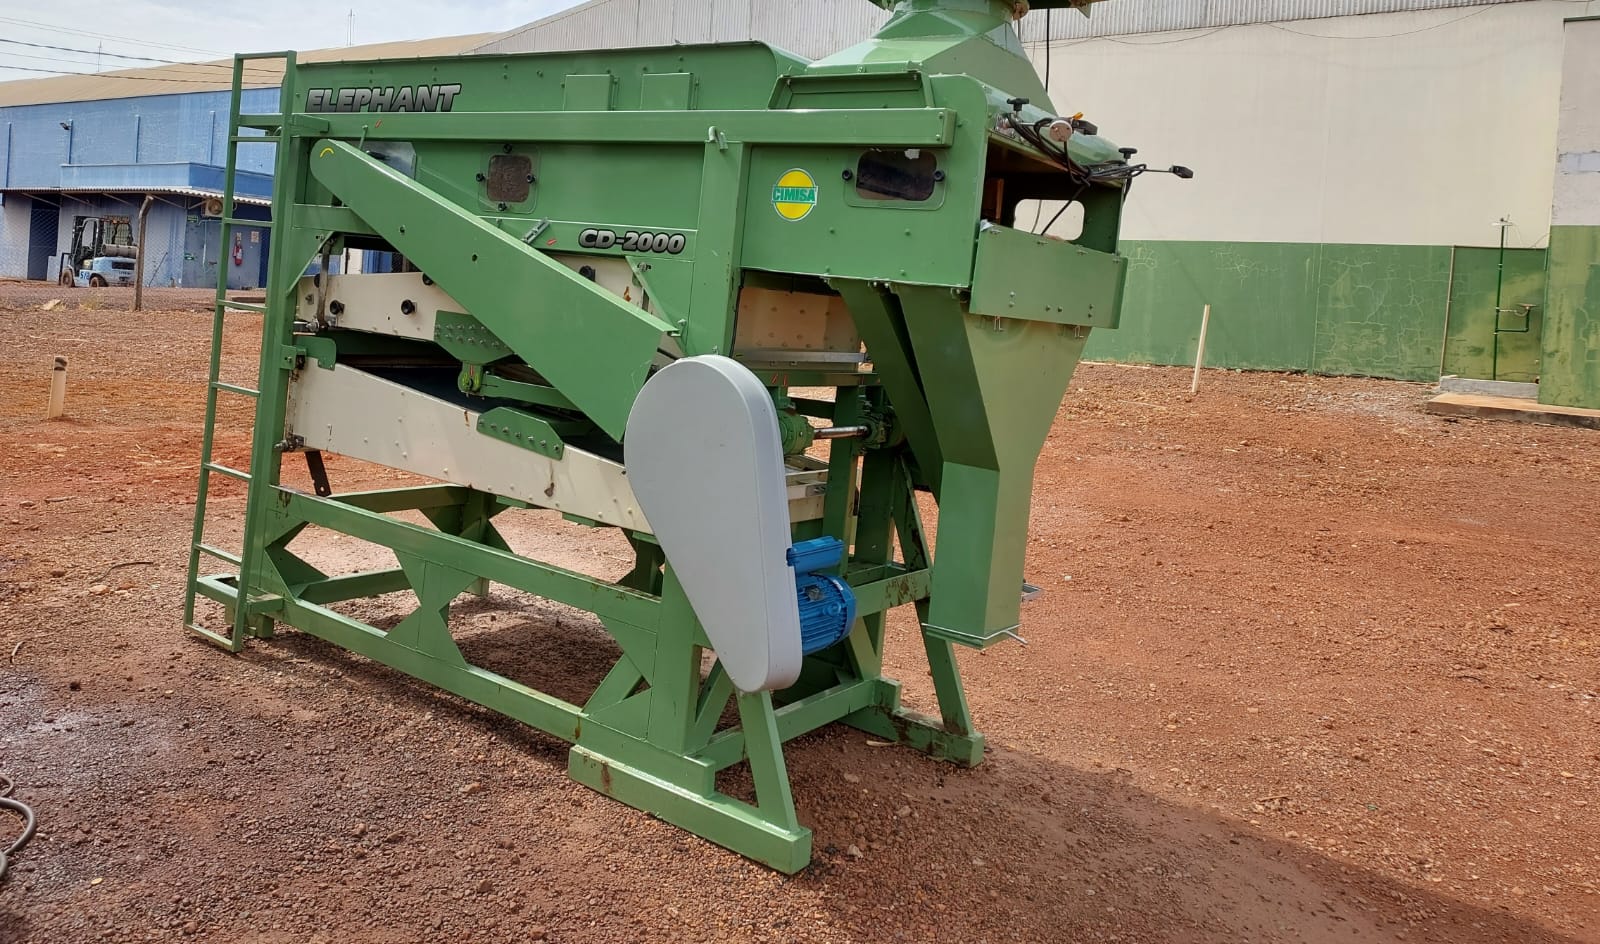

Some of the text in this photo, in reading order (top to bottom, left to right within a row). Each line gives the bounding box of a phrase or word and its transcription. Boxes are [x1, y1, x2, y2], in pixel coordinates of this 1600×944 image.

[305, 83, 462, 112] ELEPHANT
[773, 187, 815, 202] CIMISA
[579, 228, 686, 254] CD-2000
